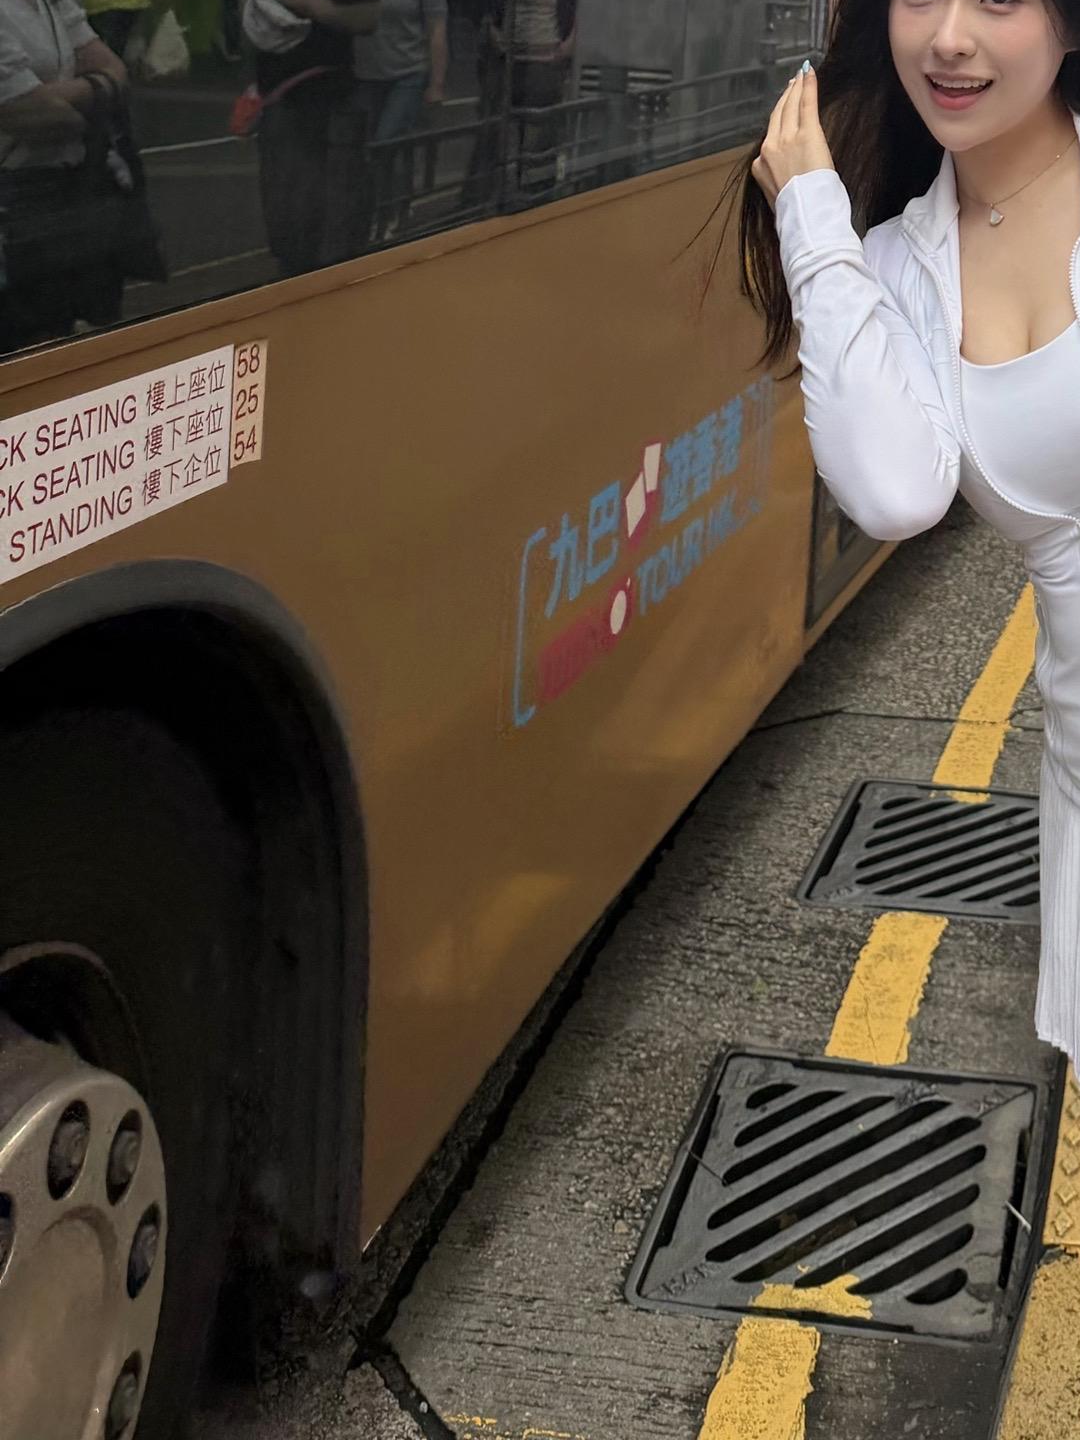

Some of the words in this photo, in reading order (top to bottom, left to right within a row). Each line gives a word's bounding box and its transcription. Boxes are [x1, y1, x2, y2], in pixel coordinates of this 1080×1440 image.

[32, 440, 135, 505] SEATING
[144, 402, 225, 461] 樓下座位
[235, 383, 260, 421] 25
[34, 394, 137, 457] SEATING
[146, 360, 226, 417] 樓上座位
[236, 343, 261, 379] 58
[9, 485, 134, 563] STANDING
[142, 445, 223, 506] 樓下企位
[233, 425, 257, 461] 54
[544, 480, 621, 620] 九巴
